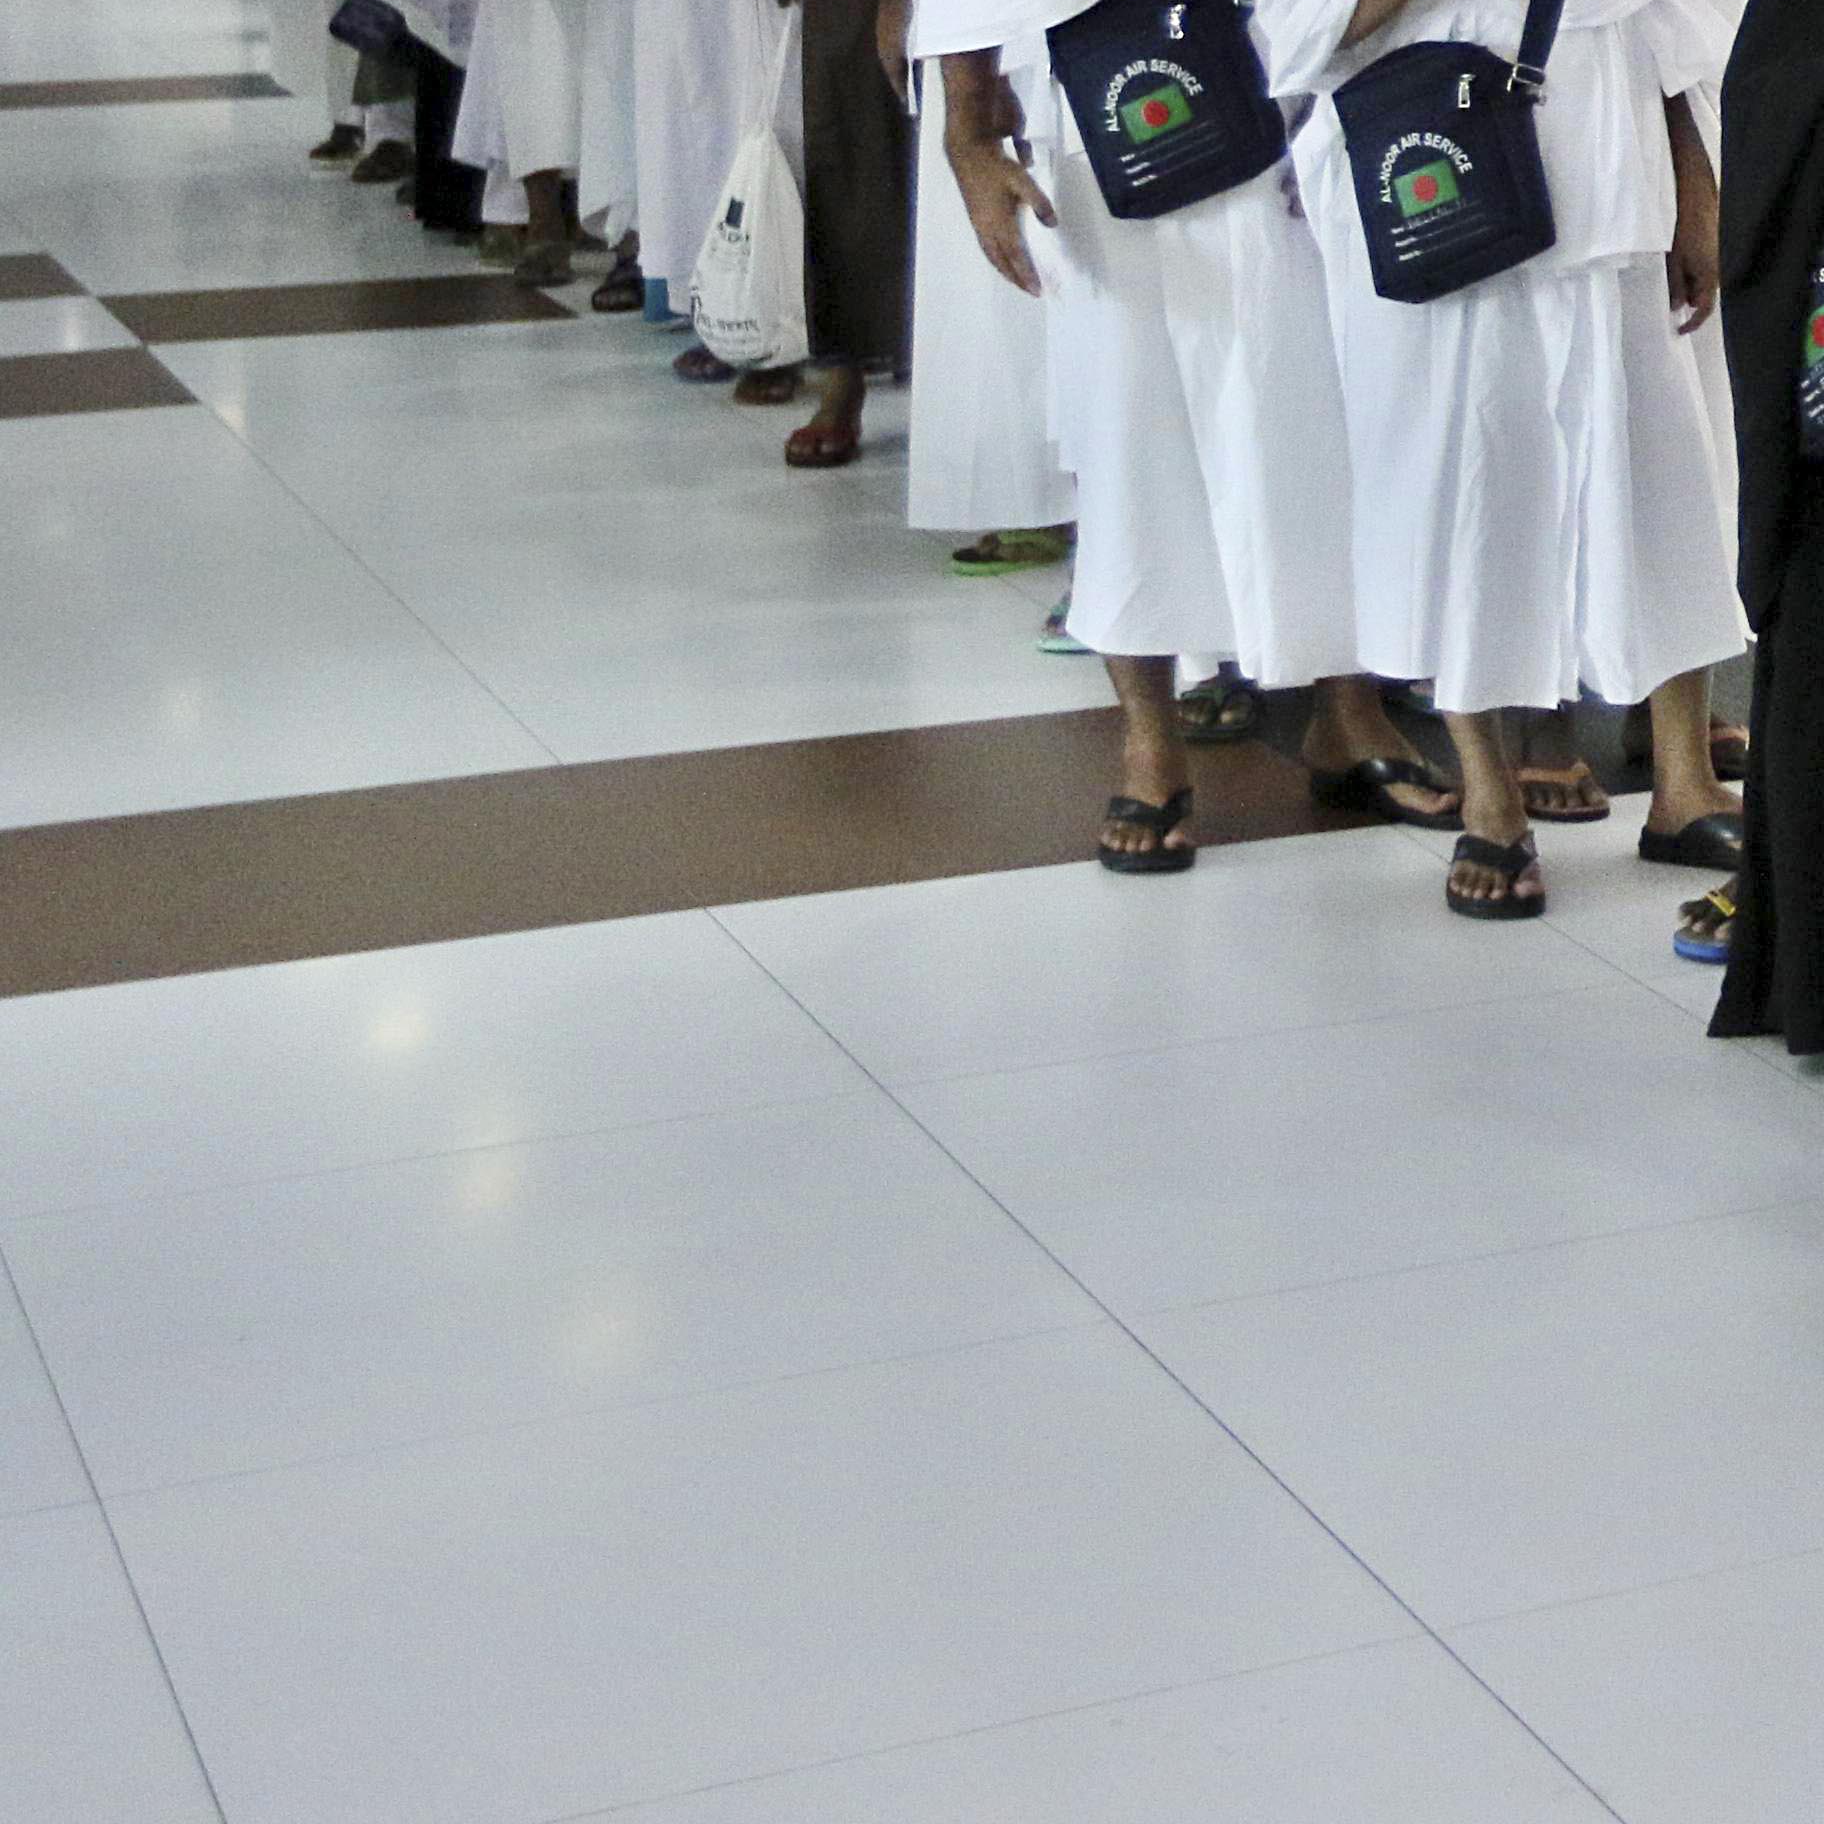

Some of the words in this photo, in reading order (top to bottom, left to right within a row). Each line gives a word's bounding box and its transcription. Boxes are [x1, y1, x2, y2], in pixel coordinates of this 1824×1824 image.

[1125, 60, 1148, 78] AIR
[1150, 58, 1204, 96] SERVICE
[1380, 144, 1401, 204] AL-NOOR
[1400, 132, 1421, 151] AIR
[1424, 132, 1473, 174] SERVICE
